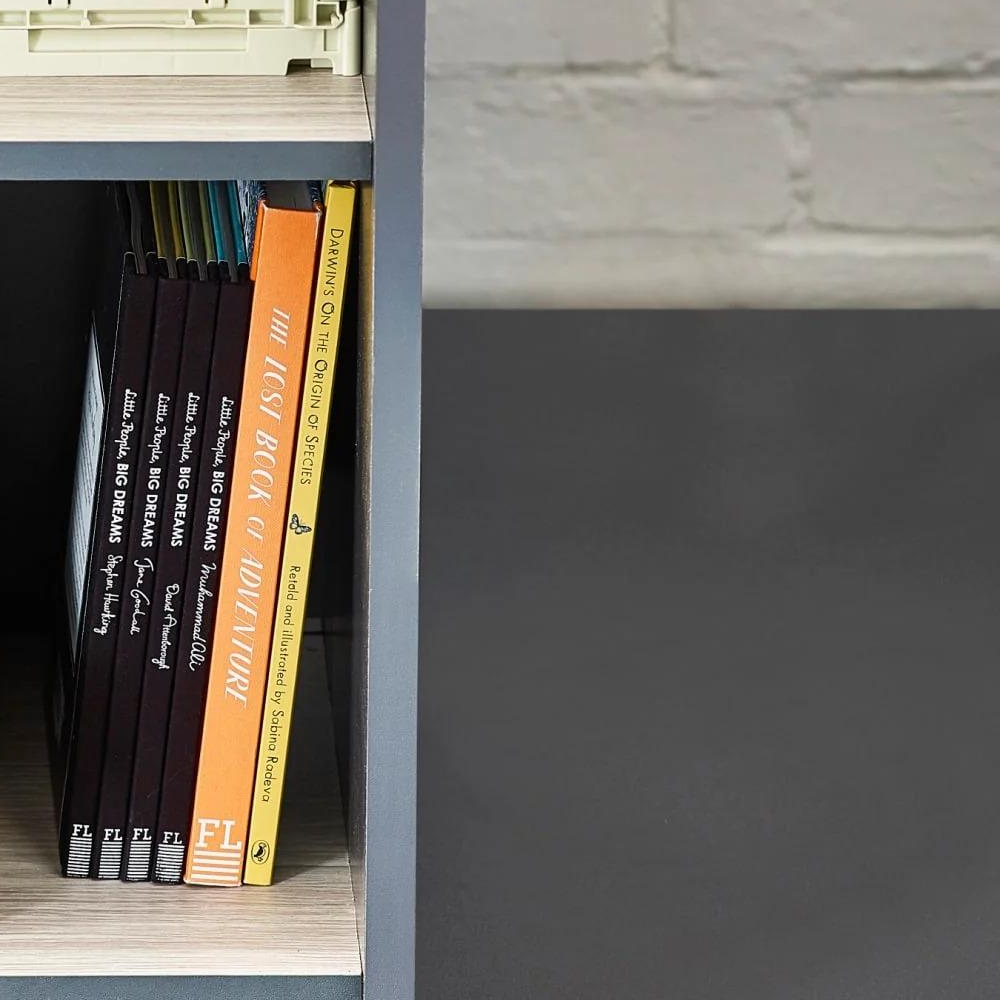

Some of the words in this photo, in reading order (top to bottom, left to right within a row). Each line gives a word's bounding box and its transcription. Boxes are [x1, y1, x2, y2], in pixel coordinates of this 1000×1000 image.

[324, 228, 344, 297] DARWIN'S
[269, 306, 291, 349] THE
[320, 301, 335, 326] ON
[316, 331, 330, 354] THE
[259, 355, 288, 424] LOST
[309, 359, 328, 409] ORIGIN
[123, 388, 137, 420] Little
[156, 393, 170, 424] Little
[186, 392, 200, 423] Little
[219, 396, 234, 428] Little
[114, 421, 134, 460] People,
[306, 415, 319, 434] OF
[148, 425, 167, 464] People,
[178, 425, 196, 462] People,
[212, 429, 231, 467] People,
[300, 435, 319, 485] SPECIES
[116, 462, 129, 489] BIG
[148, 467, 161, 490] BIG
[178, 466, 191, 490] BIG
[212, 470, 227, 494] BIG
[247, 429, 278, 508] BOOK
[109, 491, 125, 543] DREAMS
[141, 495, 157, 546] DREAMS
[171, 493, 188, 546] DREAMS
[204, 497, 220, 550] DREAMS
[100, 554, 122, 590] Stephen
[133, 558, 154, 588] Jane
[286, 565, 301, 601] Retold
[94, 592, 119, 635] Hawking
[131, 589, 150, 635] Goodall
[164, 583, 180, 612] David
[193, 563, 216, 640] Muhammad
[283, 605, 293, 626] and
[152, 612, 177, 669] Attenborough
[225, 548, 264, 708] ADVENTURE
[277, 627, 293, 686] illustrated
[271, 690, 285, 705] by
[269, 709, 285, 751] Sabina
[262, 756, 278, 802] Radeva
[72, 824, 92, 837] FL
[104, 829, 122, 841] FL
[133, 828, 152, 840] FL
[163, 831, 183, 844] FL
[198, 818, 242, 849] FL
